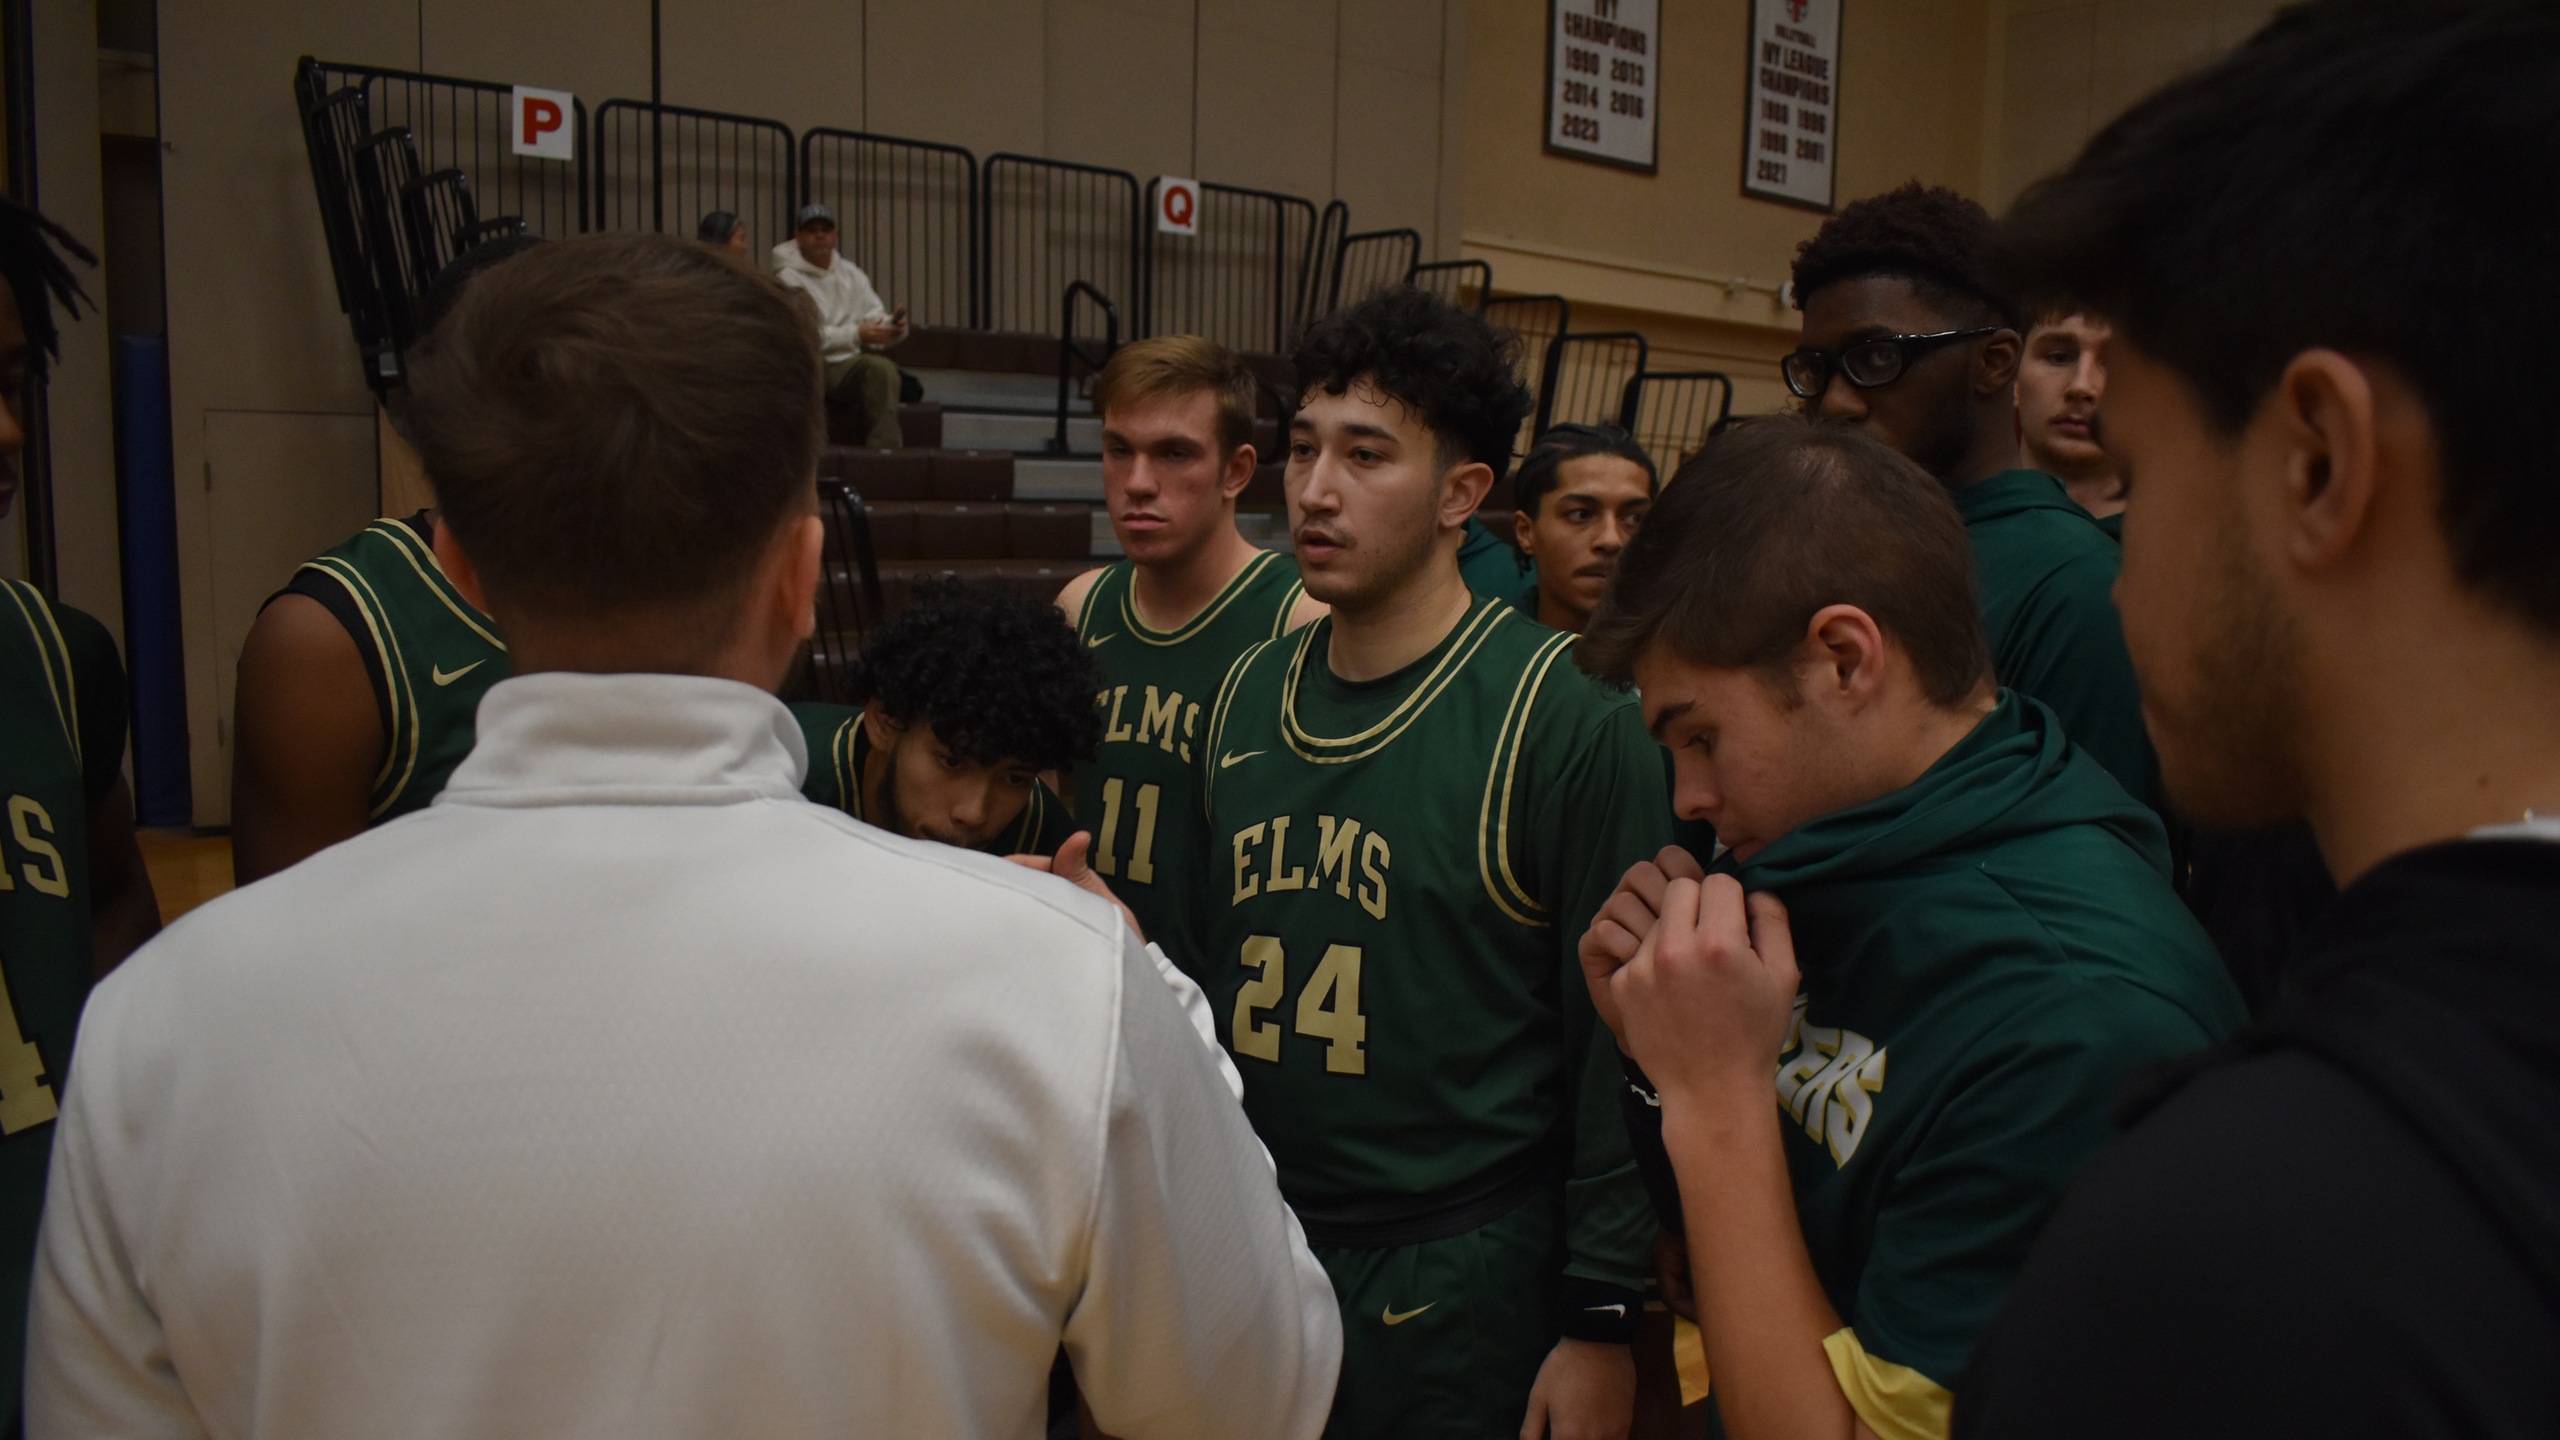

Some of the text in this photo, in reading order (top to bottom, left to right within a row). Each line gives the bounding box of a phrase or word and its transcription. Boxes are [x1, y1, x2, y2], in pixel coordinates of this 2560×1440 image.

[1565, 12, 1646, 55] CHAMPIONS
[1611, 58, 1645, 87] 2013
[1762, 40, 1829, 80] IVY LEAGUE
[1563, 80, 1645, 119] 2014 2016
[1760, 67, 1830, 105] CHAMPIONS
[522, 97, 563, 145] P
[1562, 113, 1600, 143] 2023
[1163, 186, 1193, 228] Q
[1095, 776, 1161, 885] 11
[1231, 813, 1391, 921] ELMS
[1230, 932, 1369, 1077] 24
